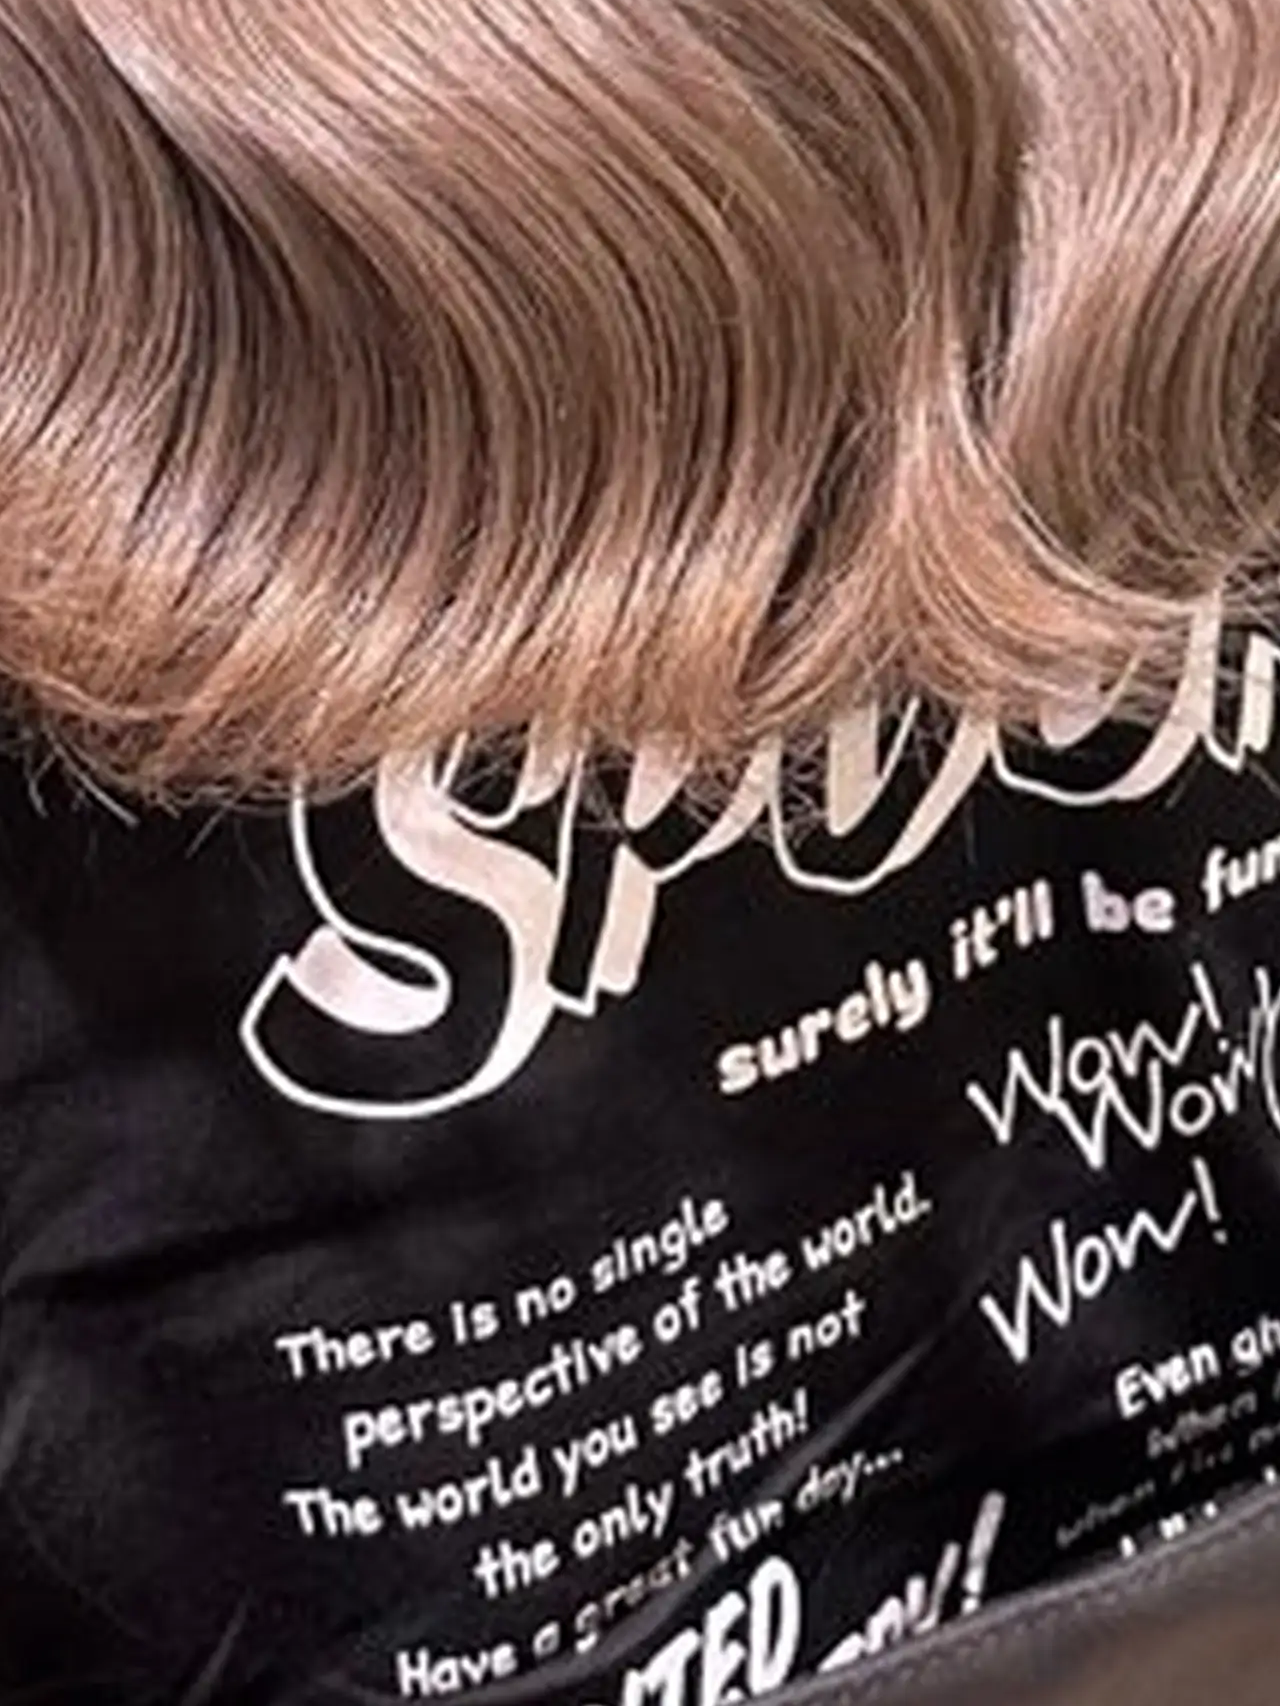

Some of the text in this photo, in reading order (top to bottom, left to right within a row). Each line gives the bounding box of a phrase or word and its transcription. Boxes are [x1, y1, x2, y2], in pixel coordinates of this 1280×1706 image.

[718, 959, 930, 1094] surely
[949, 881, 1054, 980] it'll
[1082, 870, 1175, 933] be
[966, 961, 1231, 1144] Wow!
[275, 1195, 730, 1381] There is no single
[344, 1171, 933, 1469] perspective of the world.
[980, 1155, 1227, 1364] Wow!
[284, 1290, 867, 1540] The world you see is not
[1115, 1341, 1220, 1419] Even
[474, 1388, 809, 1599] the only truth!
[397, 1642, 518, 1699] Have
[533, 1621, 560, 1657] a
[576, 1538, 695, 1653] great
[710, 1498, 783, 1562] fun
